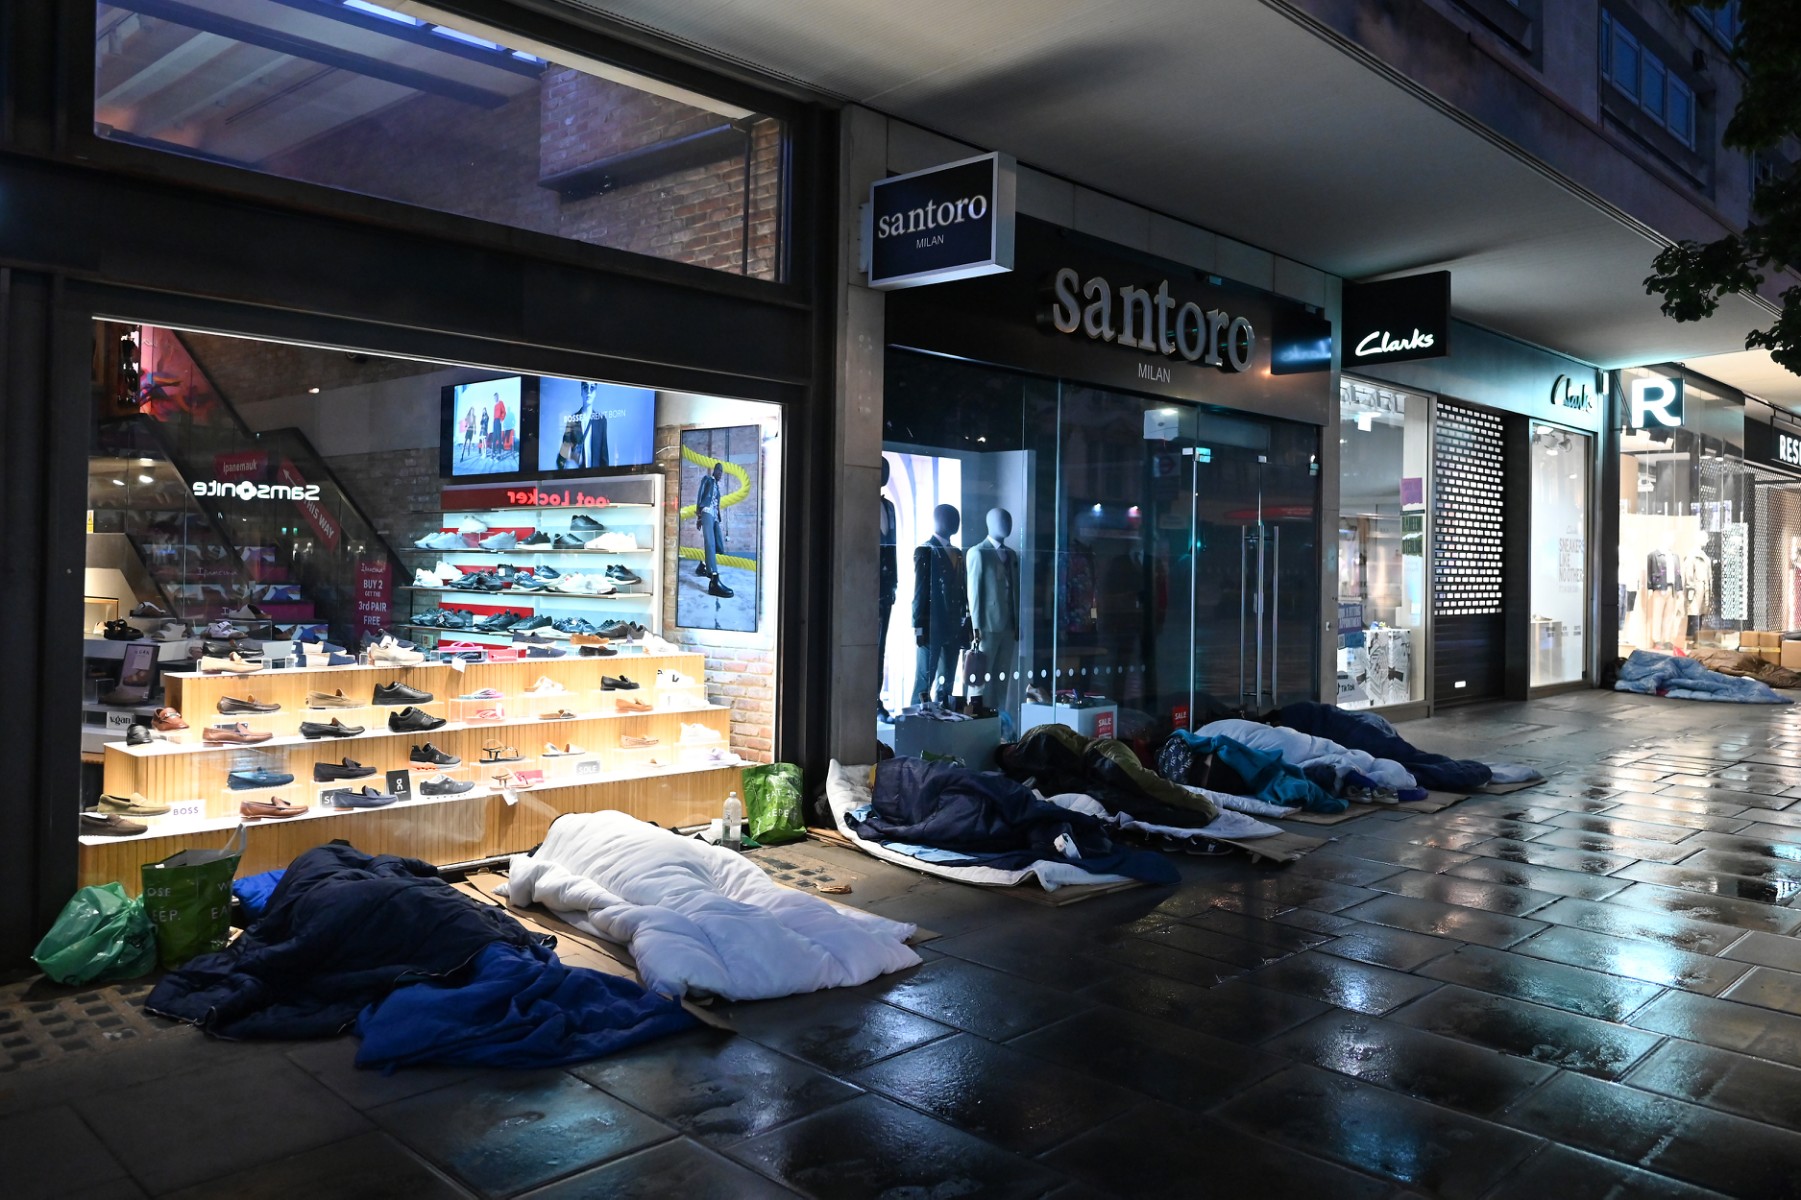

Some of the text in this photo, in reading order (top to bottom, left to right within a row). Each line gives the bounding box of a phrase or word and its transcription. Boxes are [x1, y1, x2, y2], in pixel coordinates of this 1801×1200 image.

[878, 195, 988, 239] santoro
[916, 235, 944, 249] MILAN
[1053, 268, 1255, 373] santoro
[1355, 328, 1434, 357] Clarks
[1138, 362, 1171, 383] MILAN
[1631, 378, 1682, 428] R
[319, 514, 334, 539] WAY
[364, 579, 383, 590] BUY 2
[359, 601, 387, 612] 3rd PAIR
[364, 615, 381, 625] FREE
[1098, 717, 1112, 727] SALE
[173, 806, 199, 816] BOSS
